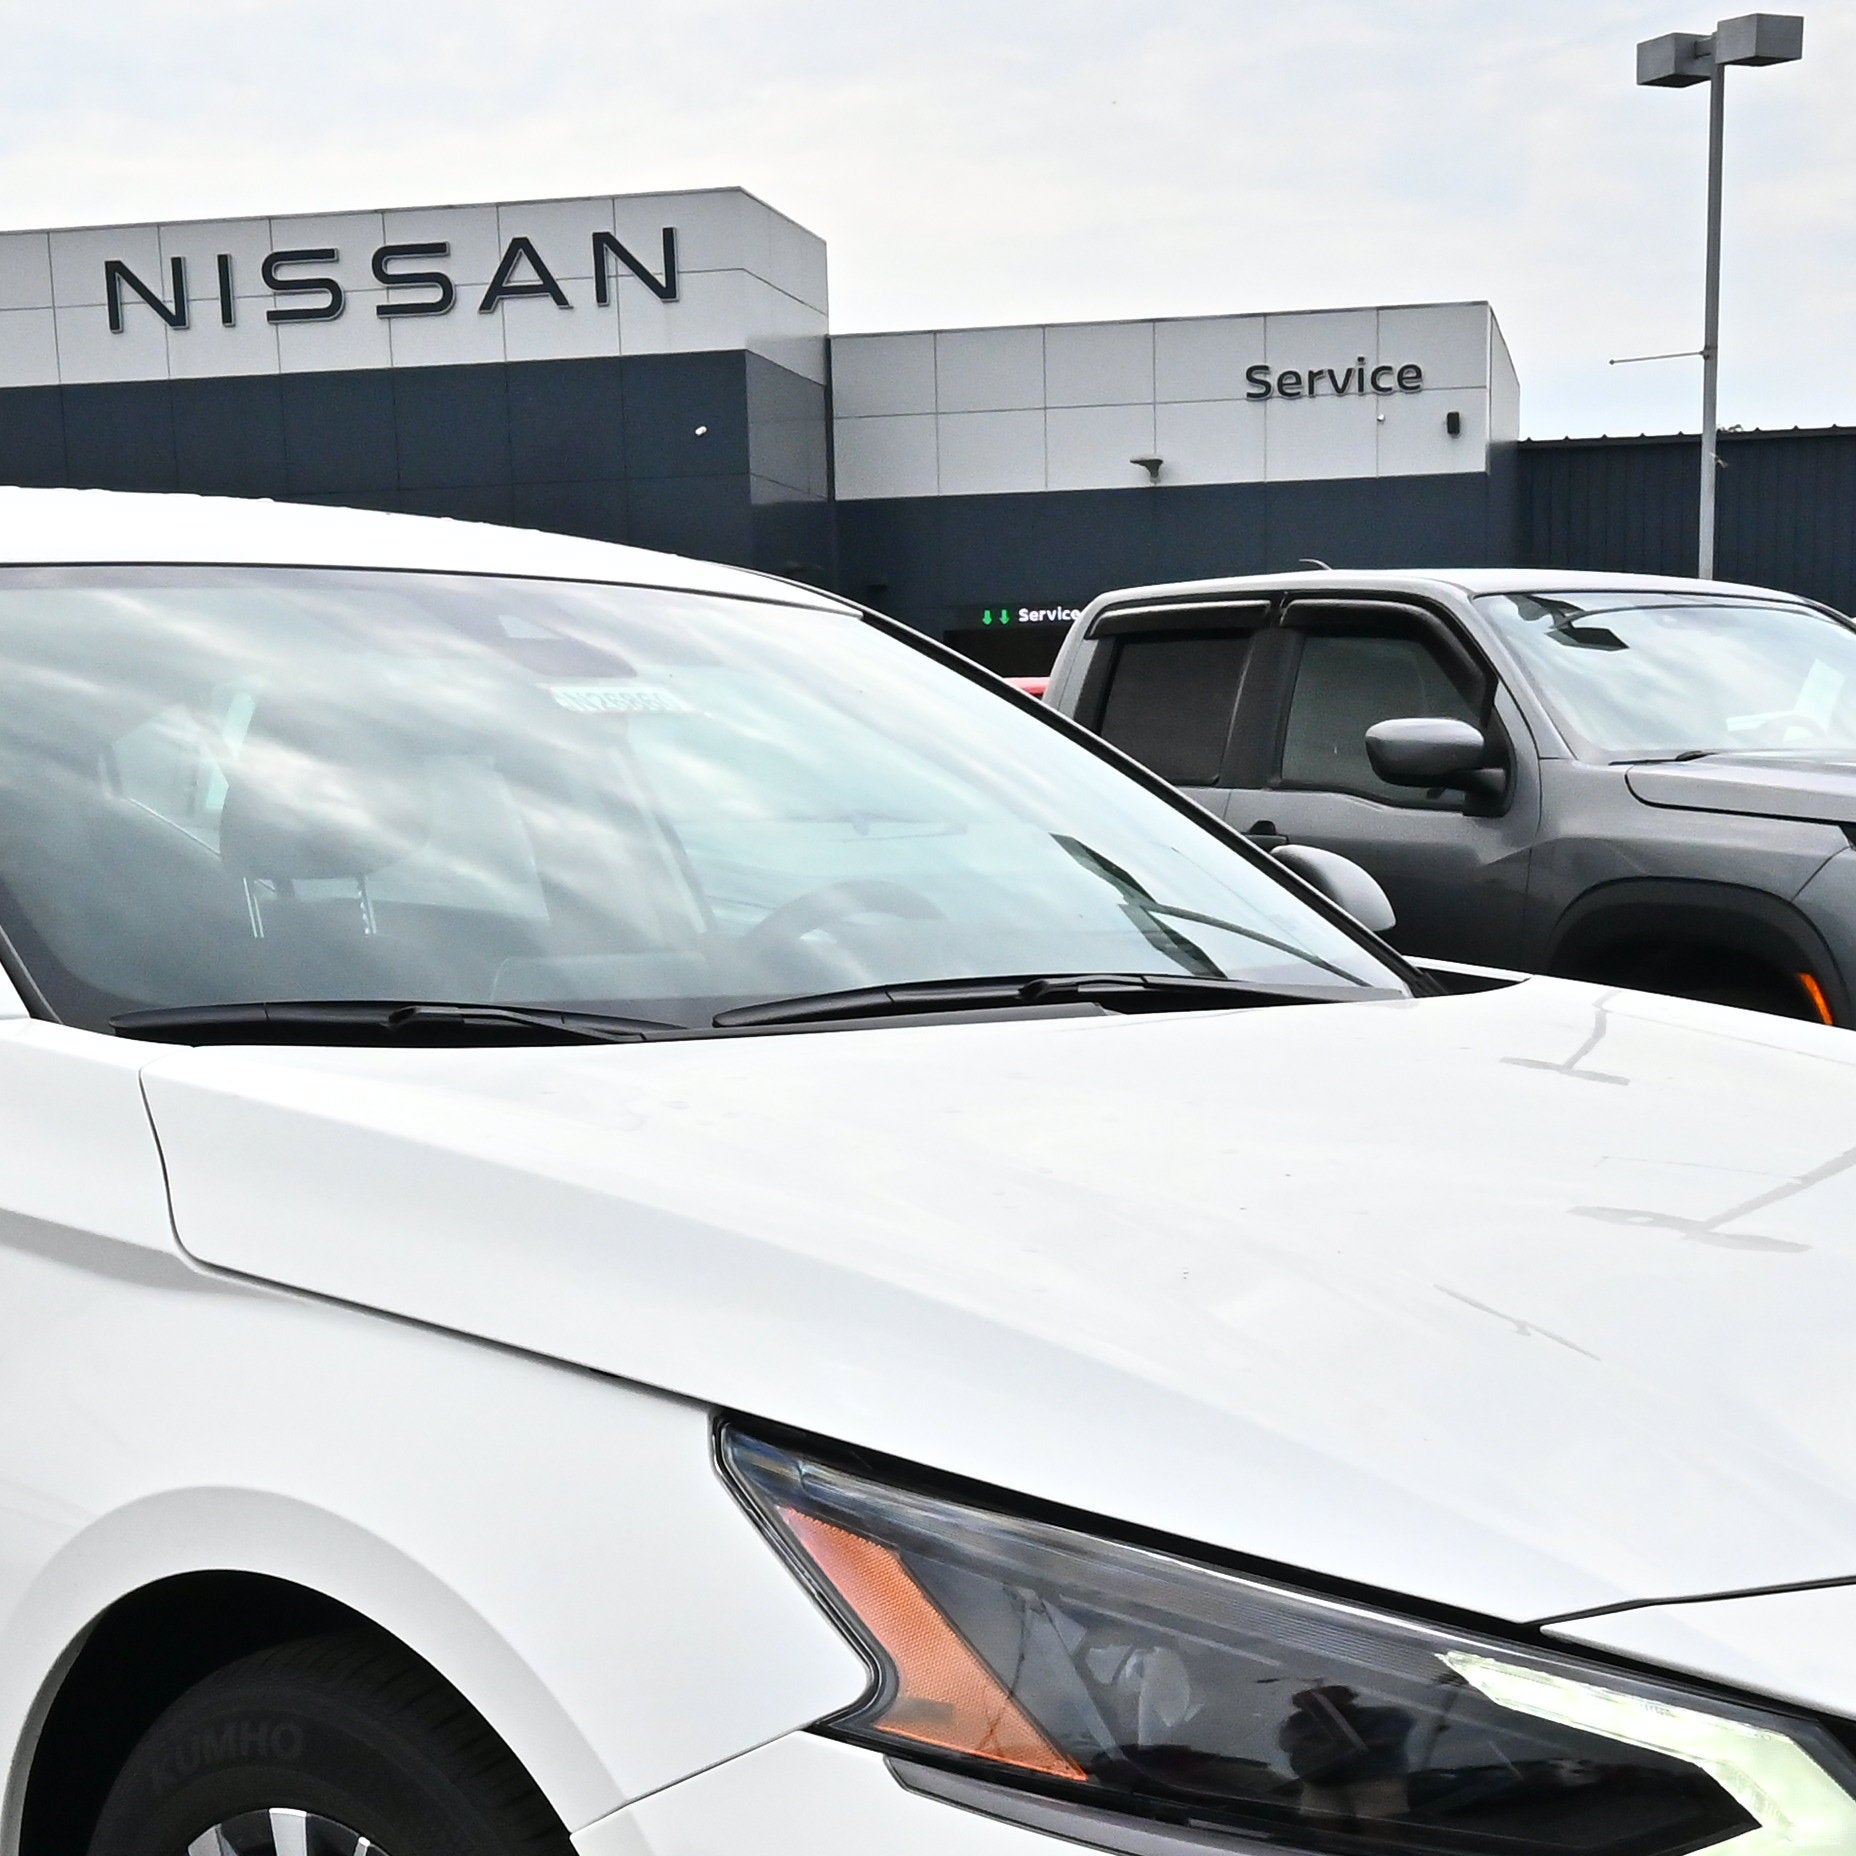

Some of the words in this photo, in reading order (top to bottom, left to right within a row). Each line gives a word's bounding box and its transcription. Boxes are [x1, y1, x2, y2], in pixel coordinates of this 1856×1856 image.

[104, 226, 678, 333] NISSAN
[1245, 356, 1423, 399] Service
[1018, 606, 1082, 623] Service
[151, 1721, 305, 1796] KUMHO
